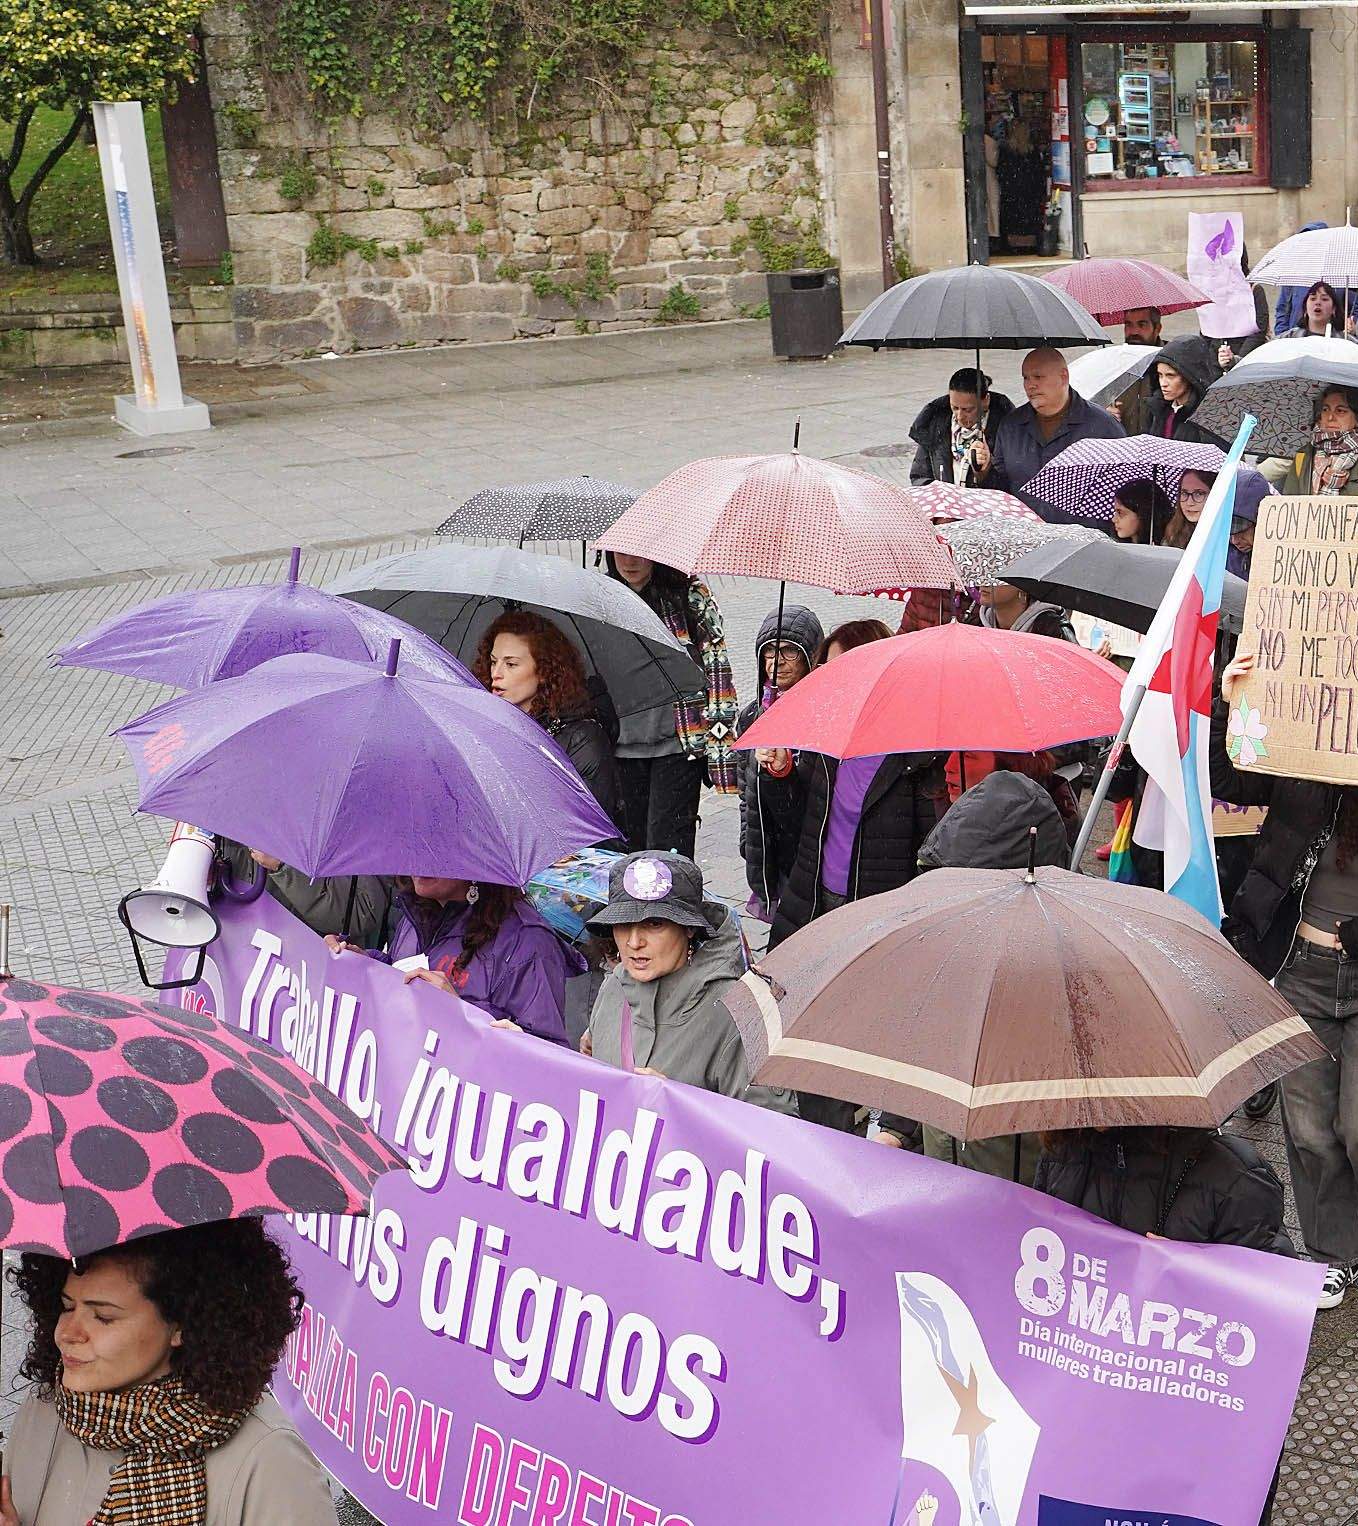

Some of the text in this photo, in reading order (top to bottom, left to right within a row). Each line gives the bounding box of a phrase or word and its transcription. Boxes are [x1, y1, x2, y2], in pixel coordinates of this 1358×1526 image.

[1265, 502, 1302, 540] CON
[1273, 545, 1322, 587] BIKINI
[1324, 550, 1338, 587] O
[1256, 587, 1285, 629] SIN
[1289, 589, 1311, 632] MI
[1257, 628, 1286, 671] NO
[1300, 636, 1327, 678] ME
[1264, 680, 1283, 718] NI
[1291, 683, 1317, 725] UN
[394, 1029, 845, 1340] igualdade,
[1015, 1227, 1108, 1316] 8 DE
[419, 1216, 727, 1441] dignos
[1019, 1317, 1229, 1387] Día internacional das
[1068, 1279, 1256, 1367] MARZO
[1018, 1340, 1245, 1412] mulleres traballadoras
[362, 1371, 454, 1510] CON
[457, 1422, 695, 1526] DERE
